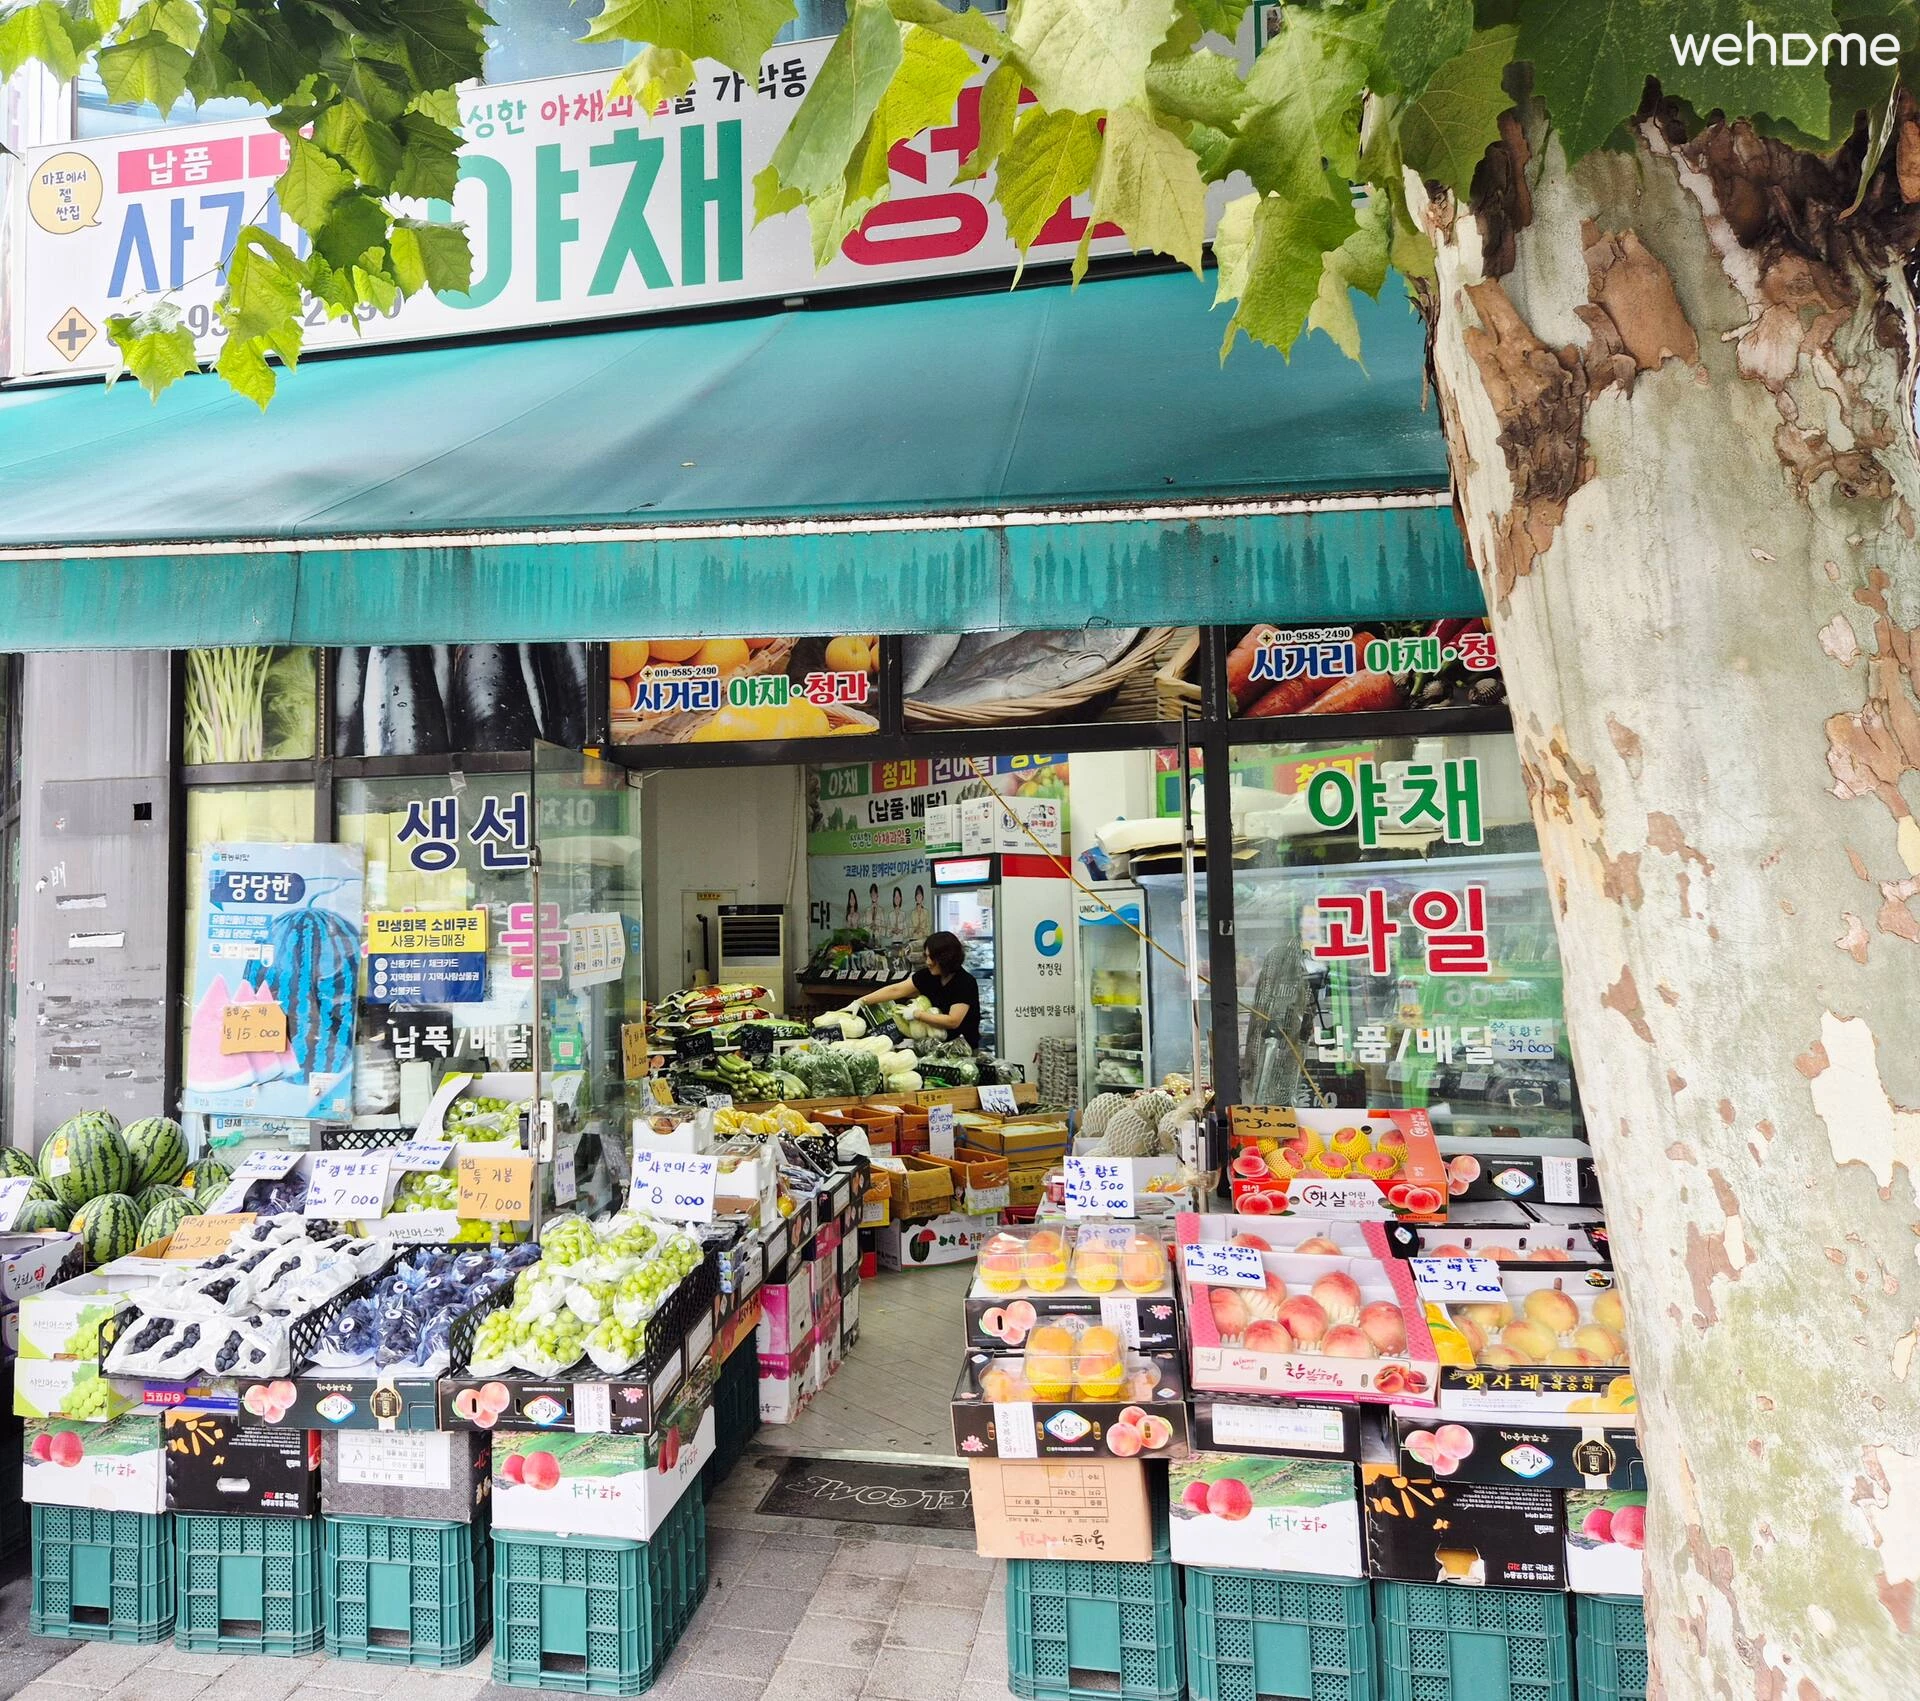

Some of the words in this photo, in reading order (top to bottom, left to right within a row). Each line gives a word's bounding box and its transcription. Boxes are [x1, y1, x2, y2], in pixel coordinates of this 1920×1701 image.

[148, 146, 212, 185] 납품
[42, 171, 87, 186] 마포에서
[59, 188, 72, 202] 젤
[56, 205, 80, 222] 싼집
[427, 118, 743, 310] 야채
[1275, 629, 1350, 642] 010-9585-2490
[1251, 644, 1354, 678] 사거리
[654, 666, 717, 677] 010-9585-2490
[634, 680, 719, 711] 사거리
[829, 769, 858, 796] 야채
[882, 760, 917, 789] 청과
[1308, 759, 1482, 845] 야채
[397, 793, 530, 870] 생선
[228, 874, 292, 901] 당당한
[377, 918, 427, 933] 민생회복
[431, 917, 478, 932] 소비쿠폰
[1313, 888, 1489, 973] 과일
[391, 933, 466, 948] 사용가능매장
[389, 959, 421, 968] 신용카드
[1037, 962, 1062, 977] 청정원
[1014, 1005, 1045, 1018] 신선함에
[1046, 1005, 1062, 1017] 맛을
[1310, 1190, 1347, 1208] 햇살
[1465, 1373, 1540, 1391] 햇사레
